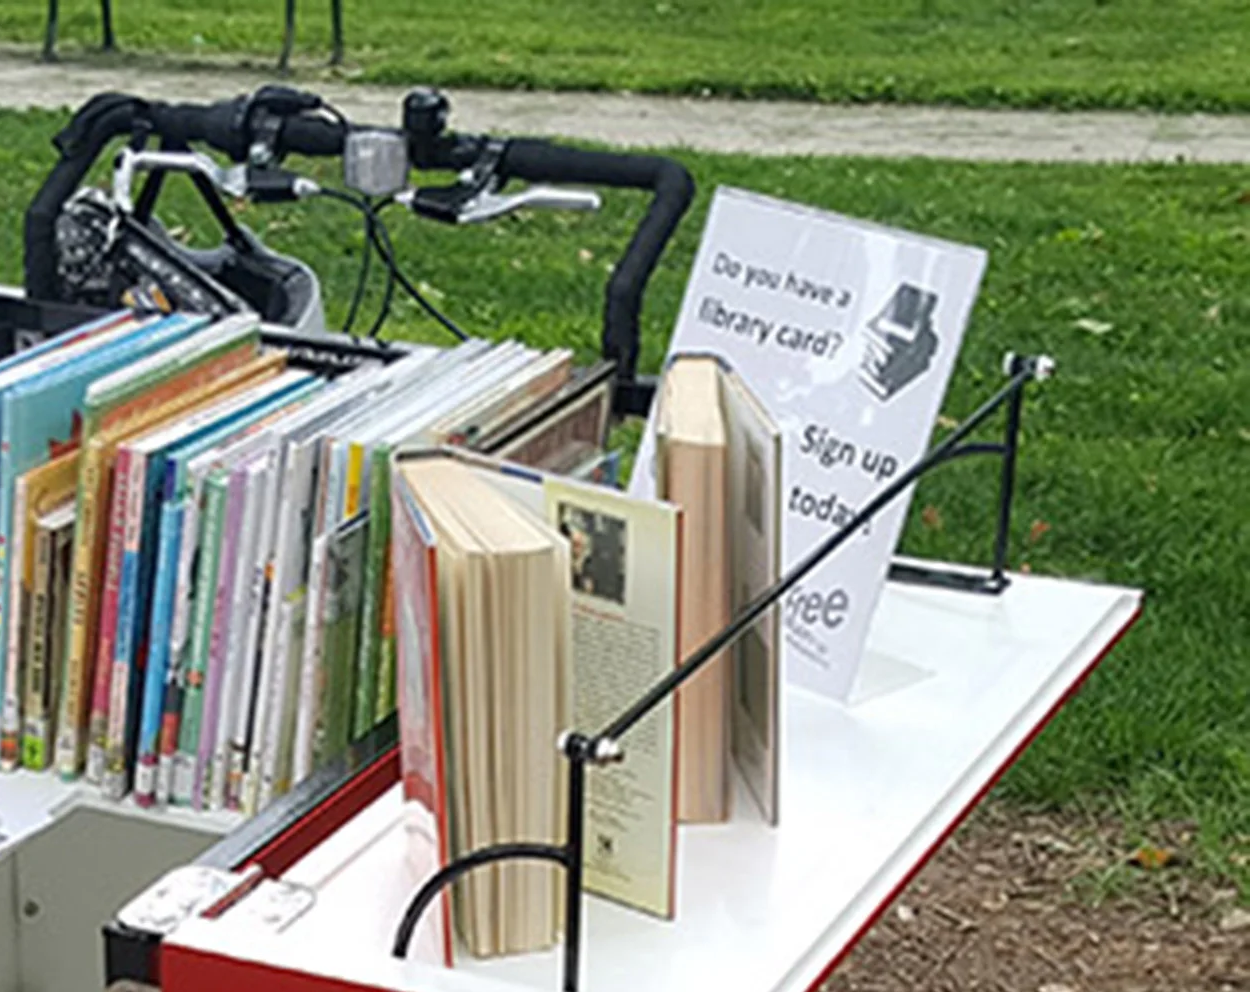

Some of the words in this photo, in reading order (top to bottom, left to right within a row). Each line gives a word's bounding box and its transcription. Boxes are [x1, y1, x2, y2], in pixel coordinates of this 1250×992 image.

[712, 252, 742, 279] Do
[744, 264, 782, 290] you
[784, 271, 834, 305] have
[837, 290, 851, 308] a
[699, 297, 775, 346] library
[776, 325, 845, 360] card?
[800, 424, 856, 468] Sign
[861, 449, 899, 482] up
[789, 486, 870, 536] toda
